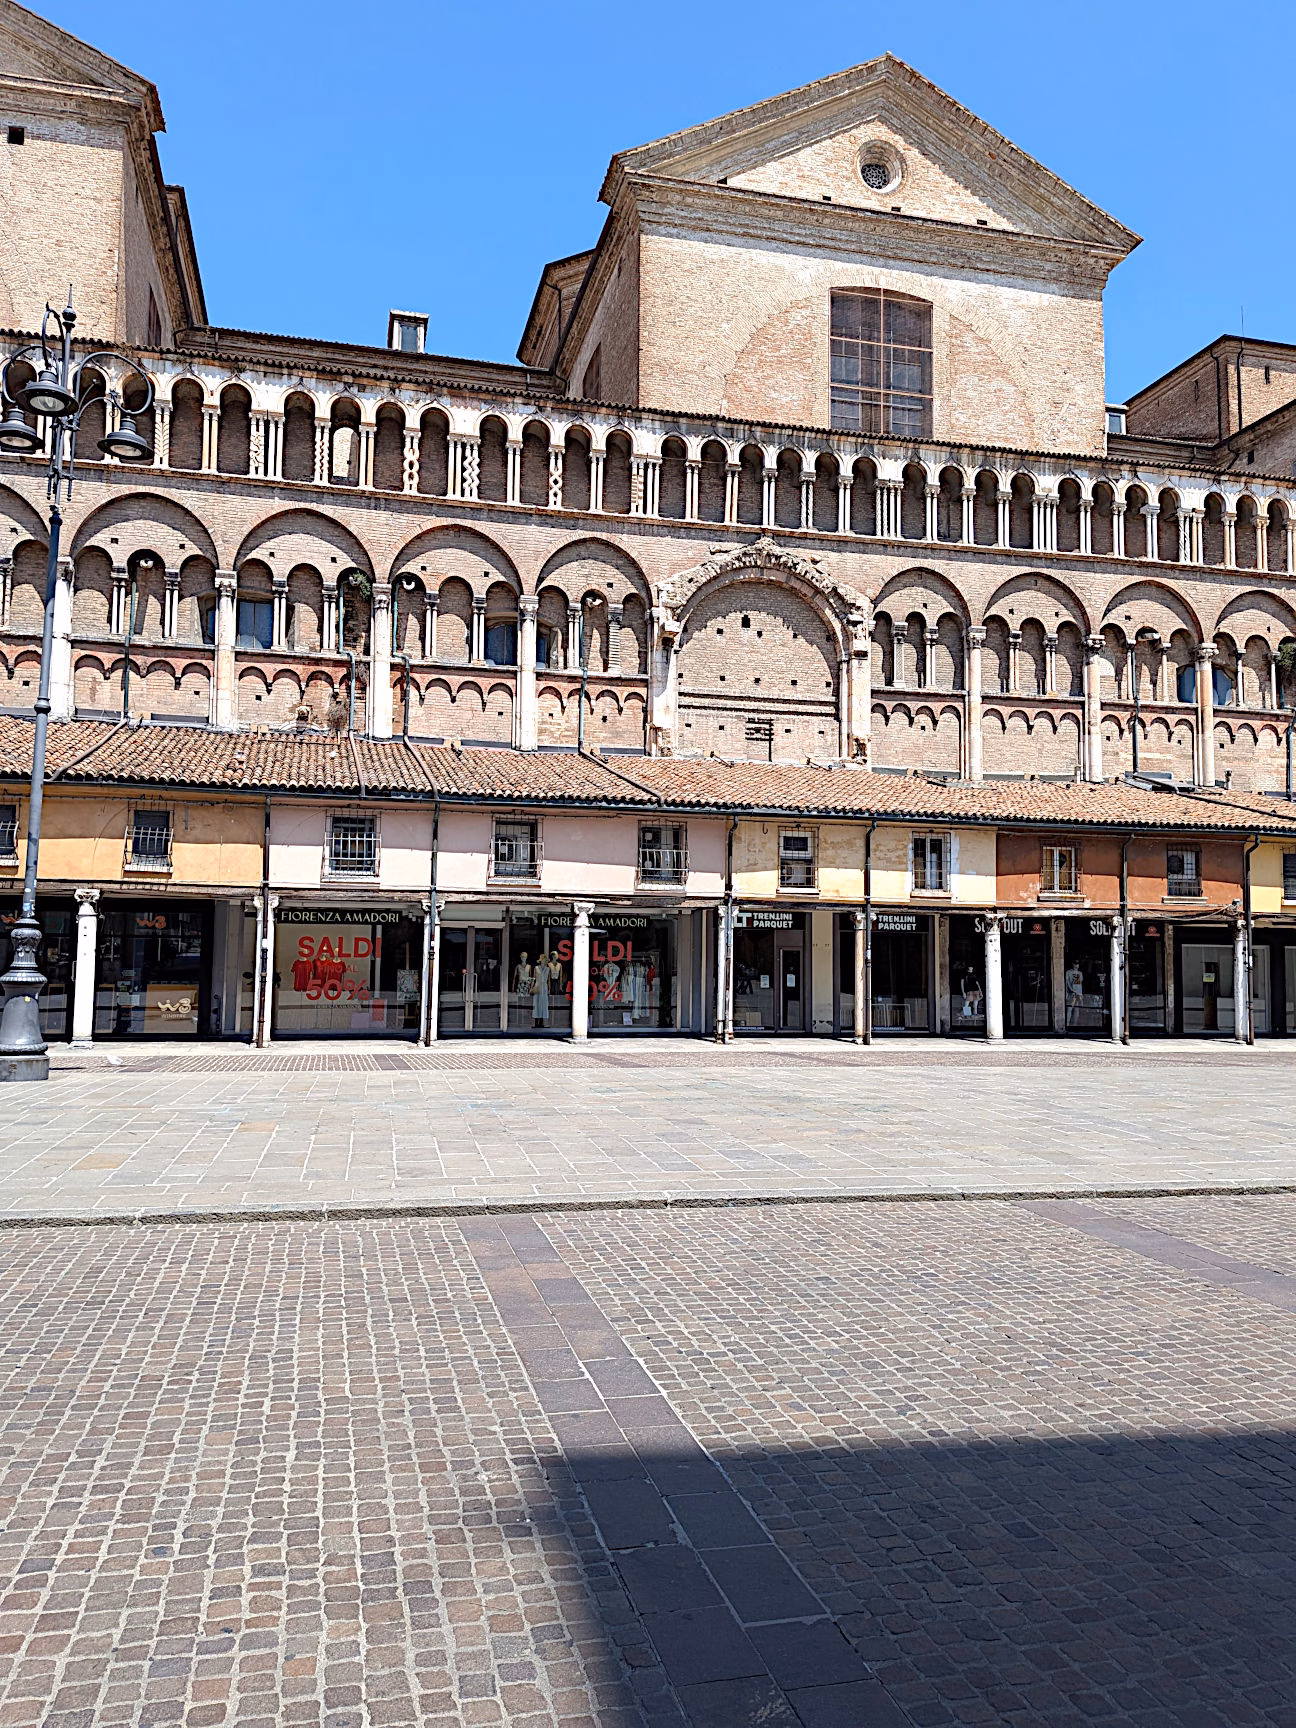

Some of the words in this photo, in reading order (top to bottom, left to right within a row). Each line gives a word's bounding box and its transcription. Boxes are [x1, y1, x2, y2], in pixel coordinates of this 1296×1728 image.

[281, 911, 341, 922] FIORENZA
[343, 913, 399, 923] AMADORI
[541, 916, 595, 926] FIOREA
[597, 917, 647, 927] AMADORI
[753, 920, 793, 928] PARQUET
[1003, 918, 1024, 934] OUT
[1089, 920, 1112, 936] SOL
[298, 935, 382, 959] SALDI
[557, 940, 633, 962] SLDI
[305, 979, 371, 1001] 50%
